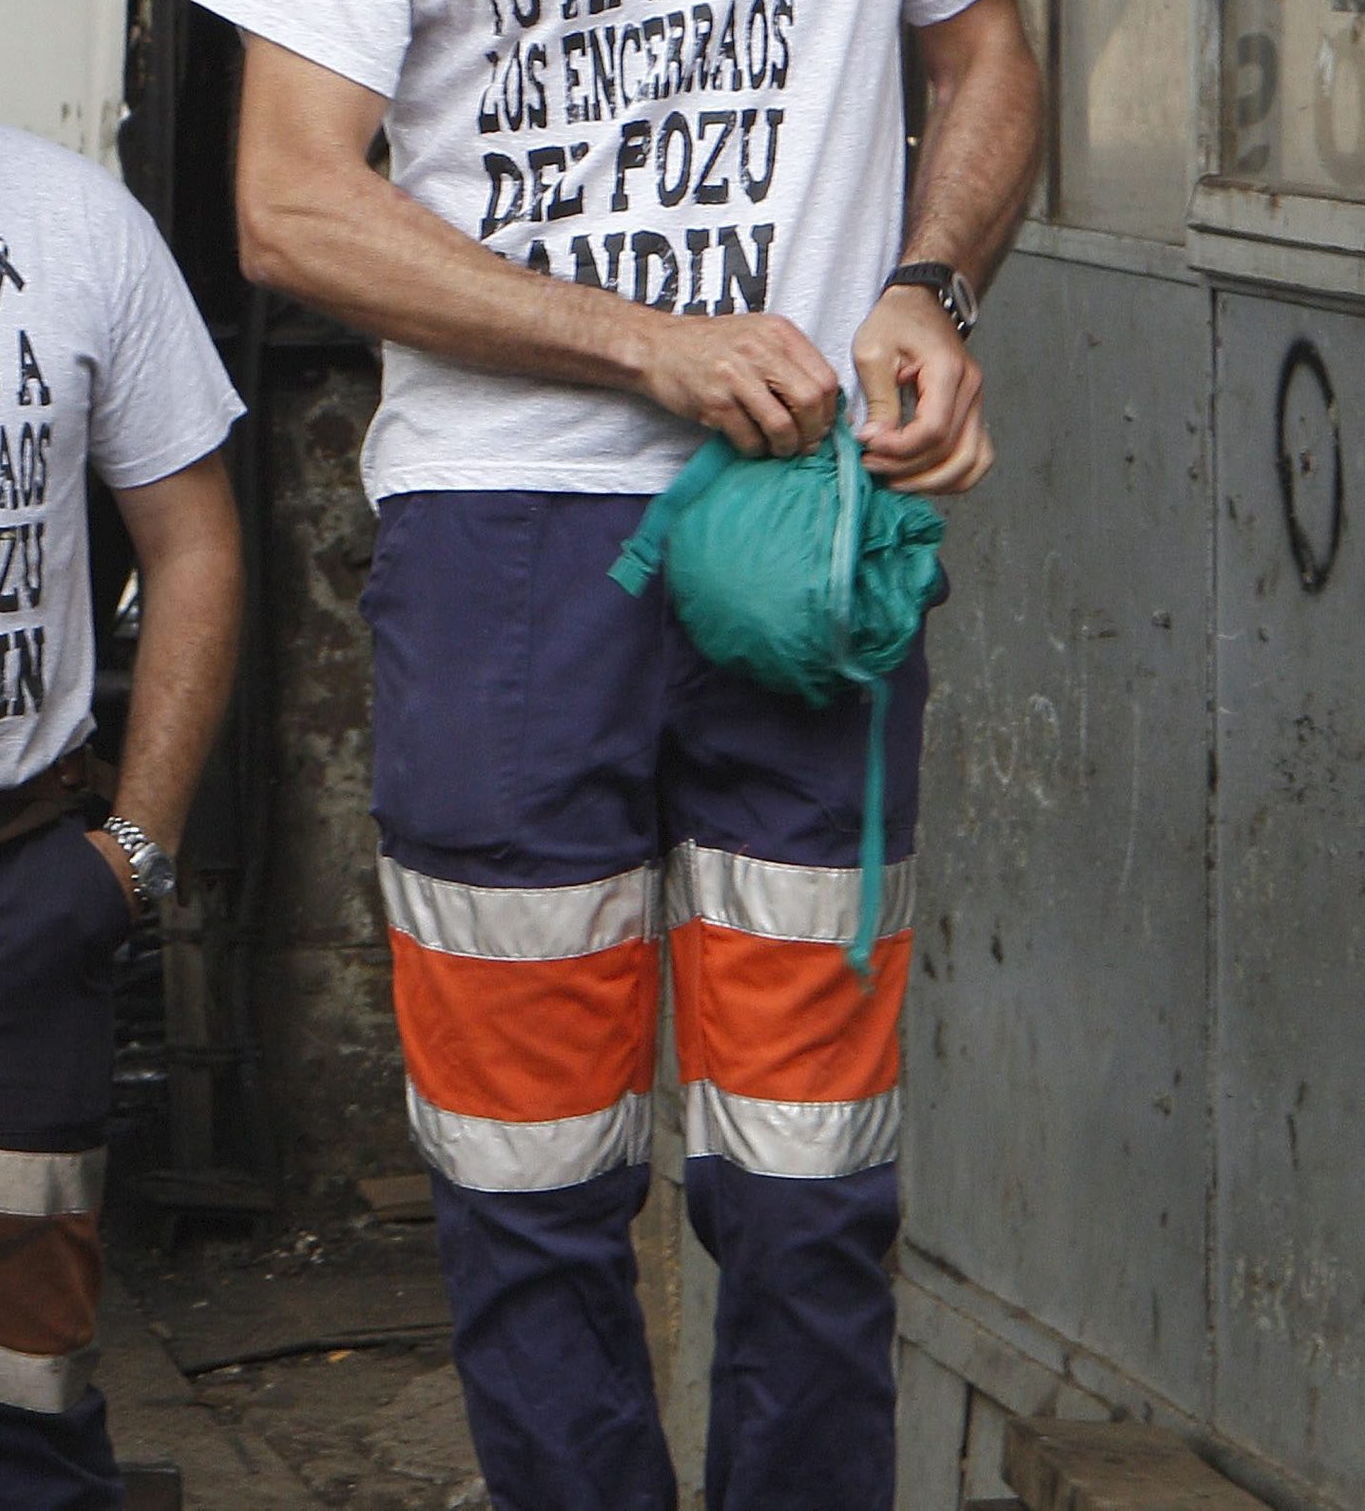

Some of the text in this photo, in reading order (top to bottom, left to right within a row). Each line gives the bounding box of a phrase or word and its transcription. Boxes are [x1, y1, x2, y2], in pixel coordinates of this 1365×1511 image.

[477, 42, 550, 135] LOS
[479, 108, 785, 241] DEL POZU
[18, 329, 52, 407] A
